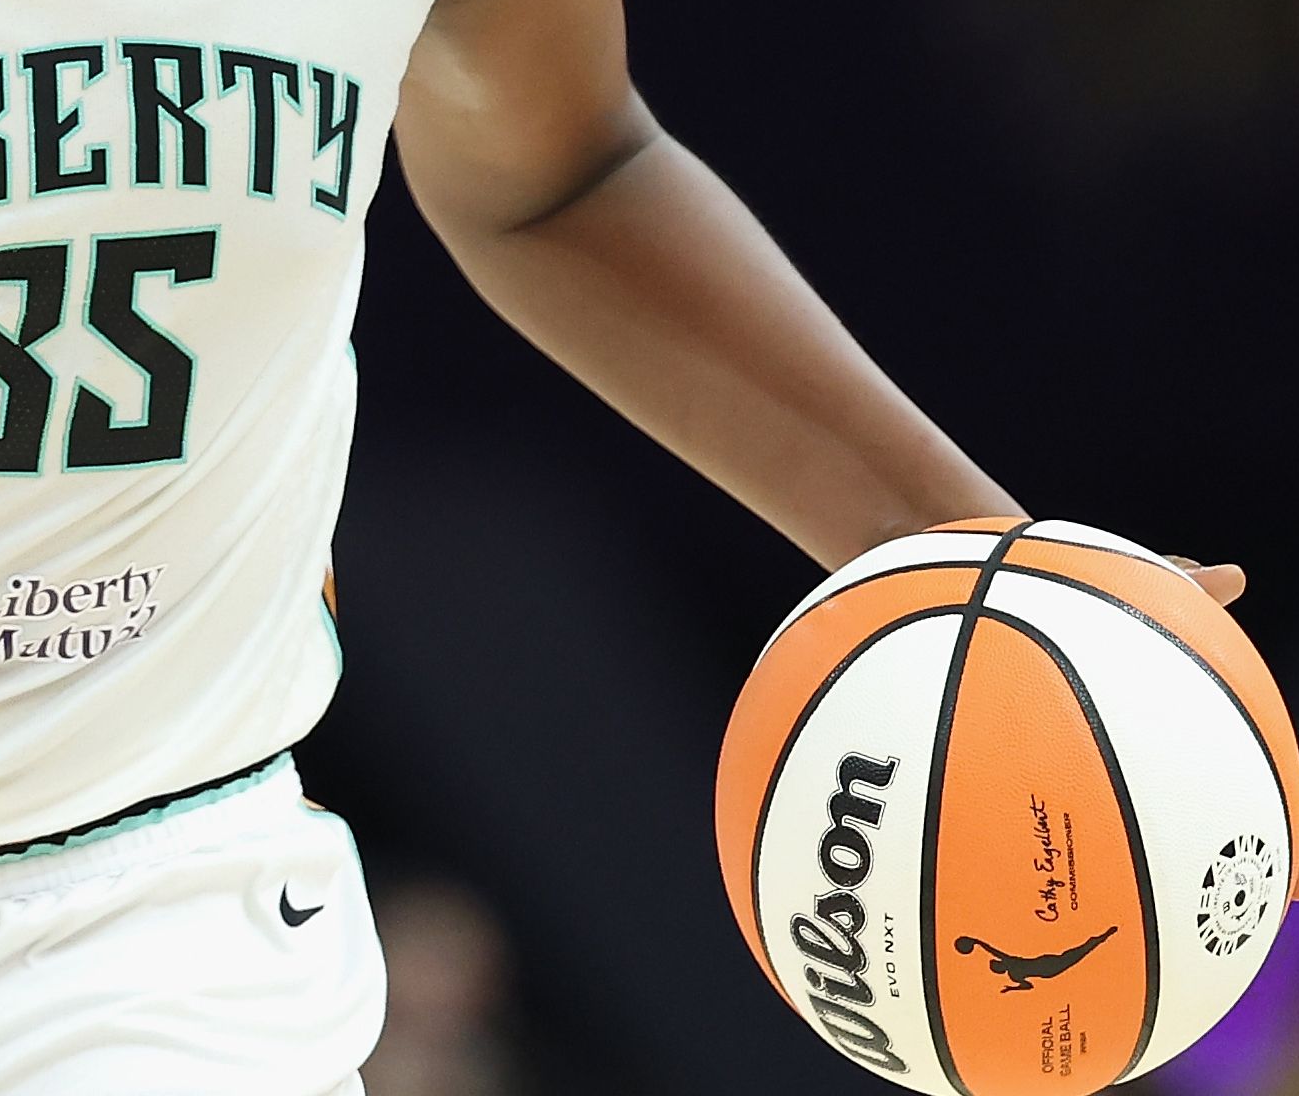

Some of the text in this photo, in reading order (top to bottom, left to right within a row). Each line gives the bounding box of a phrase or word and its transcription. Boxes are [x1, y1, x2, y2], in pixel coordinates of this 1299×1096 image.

[1064, 812, 1078, 911] COMMISSIONER
[1034, 876, 1066, 922] Cathy
[884, 912, 900, 998] EVO NXT
[1041, 1015, 1054, 1074] OFFICIAL
[1058, 1003, 1071, 1042] BALL
